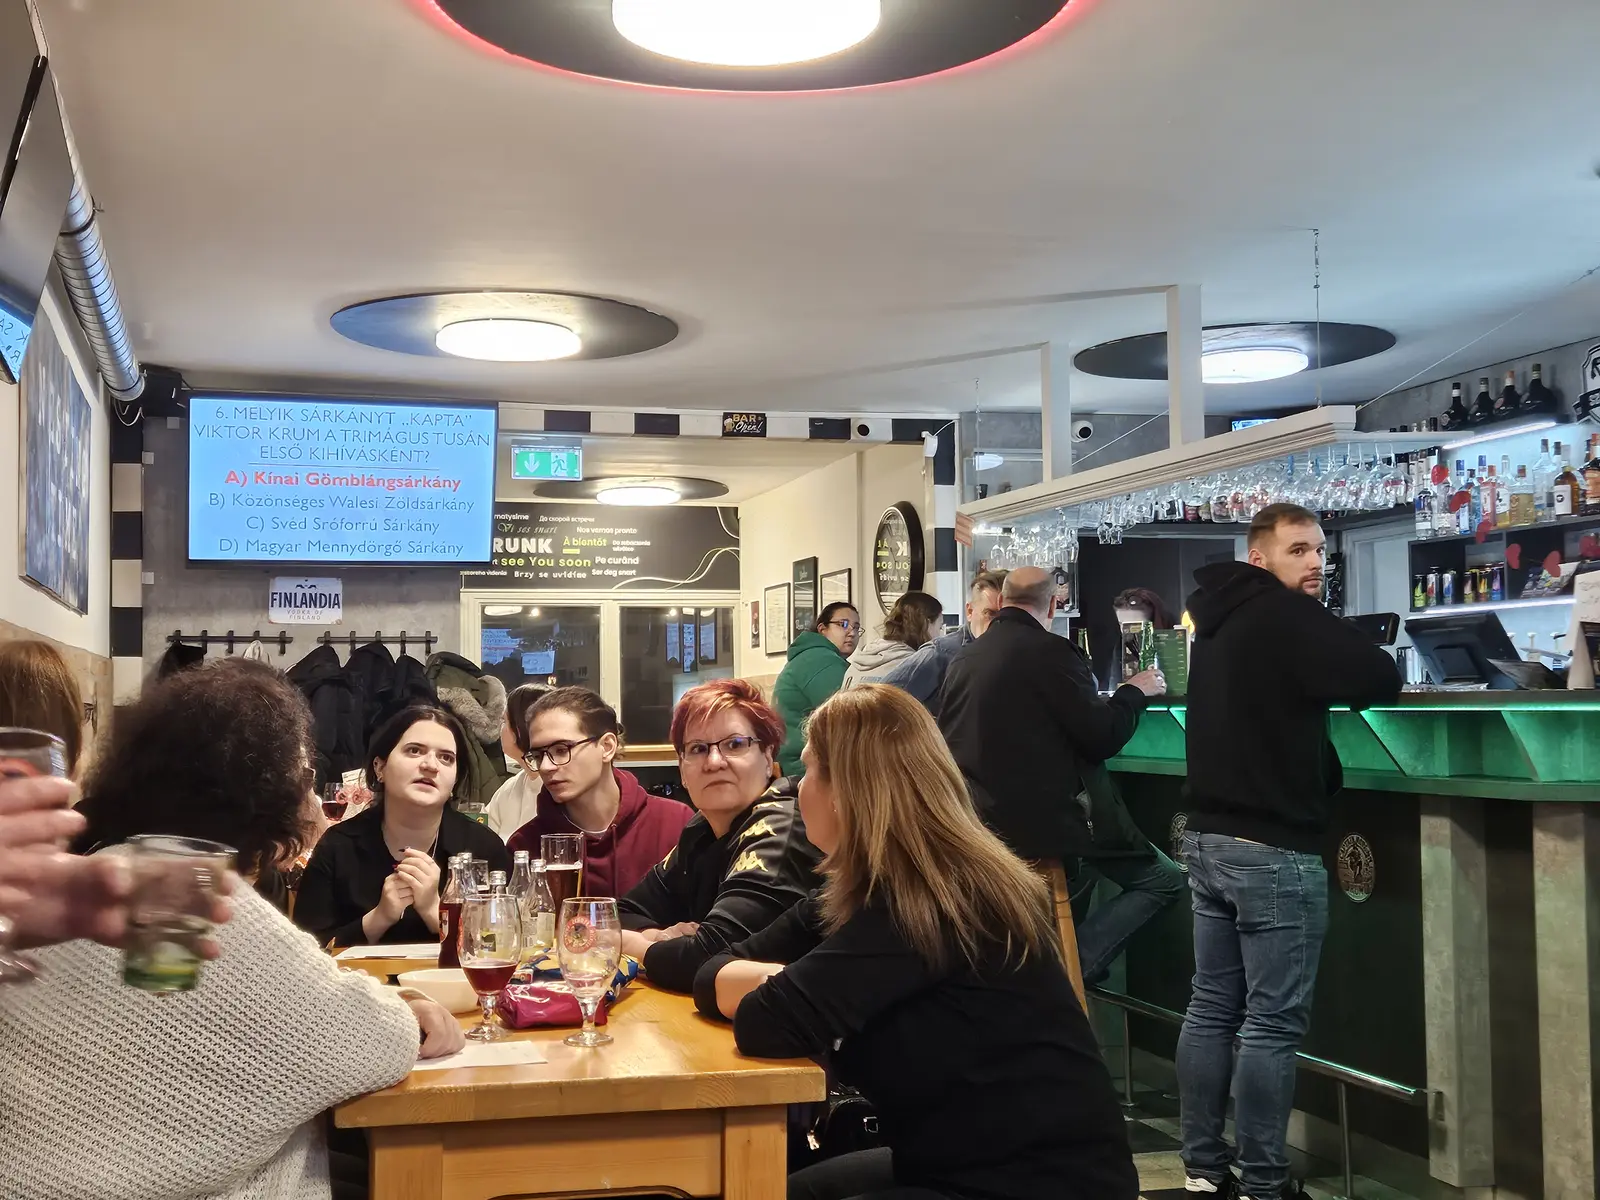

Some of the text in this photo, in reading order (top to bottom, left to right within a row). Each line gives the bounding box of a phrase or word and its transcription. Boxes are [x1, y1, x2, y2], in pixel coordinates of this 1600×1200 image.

[215, 406, 229, 419] 6.
[233, 406, 294, 421] MELYIK
[300, 406, 396, 424] SÁRKÁNYT
[733, 414, 757, 422] BAR
[194, 424, 490, 446] VIKTOR KRUM A TRIMÁGUS TUSÁN
[735, 421, 764, 433] Open!
[260, 442, 430, 463] ELSŐ KIHÍVÁSKÉNT?
[224, 470, 462, 493] A) Kínai Gömblángsárkány
[209, 492, 475, 514] B) Közönséges Walesi Zöldsárkány
[246, 516, 440, 536] C) Svéd Sróforrú Sárkány
[614, 527, 638, 536] pronto
[219, 538, 464, 557] D) Magyar Mennydörgő Sárkány
[492, 537, 553, 554] RUNK
[563, 536, 607, 547] À bientôt
[501, 558, 525, 566] see
[529, 557, 554, 567] You
[558, 559, 592, 567] soon
[595, 556, 606, 564] Pe
[514, 570, 534, 579] Brzy
[270, 592, 341, 609] FINLANDIA
